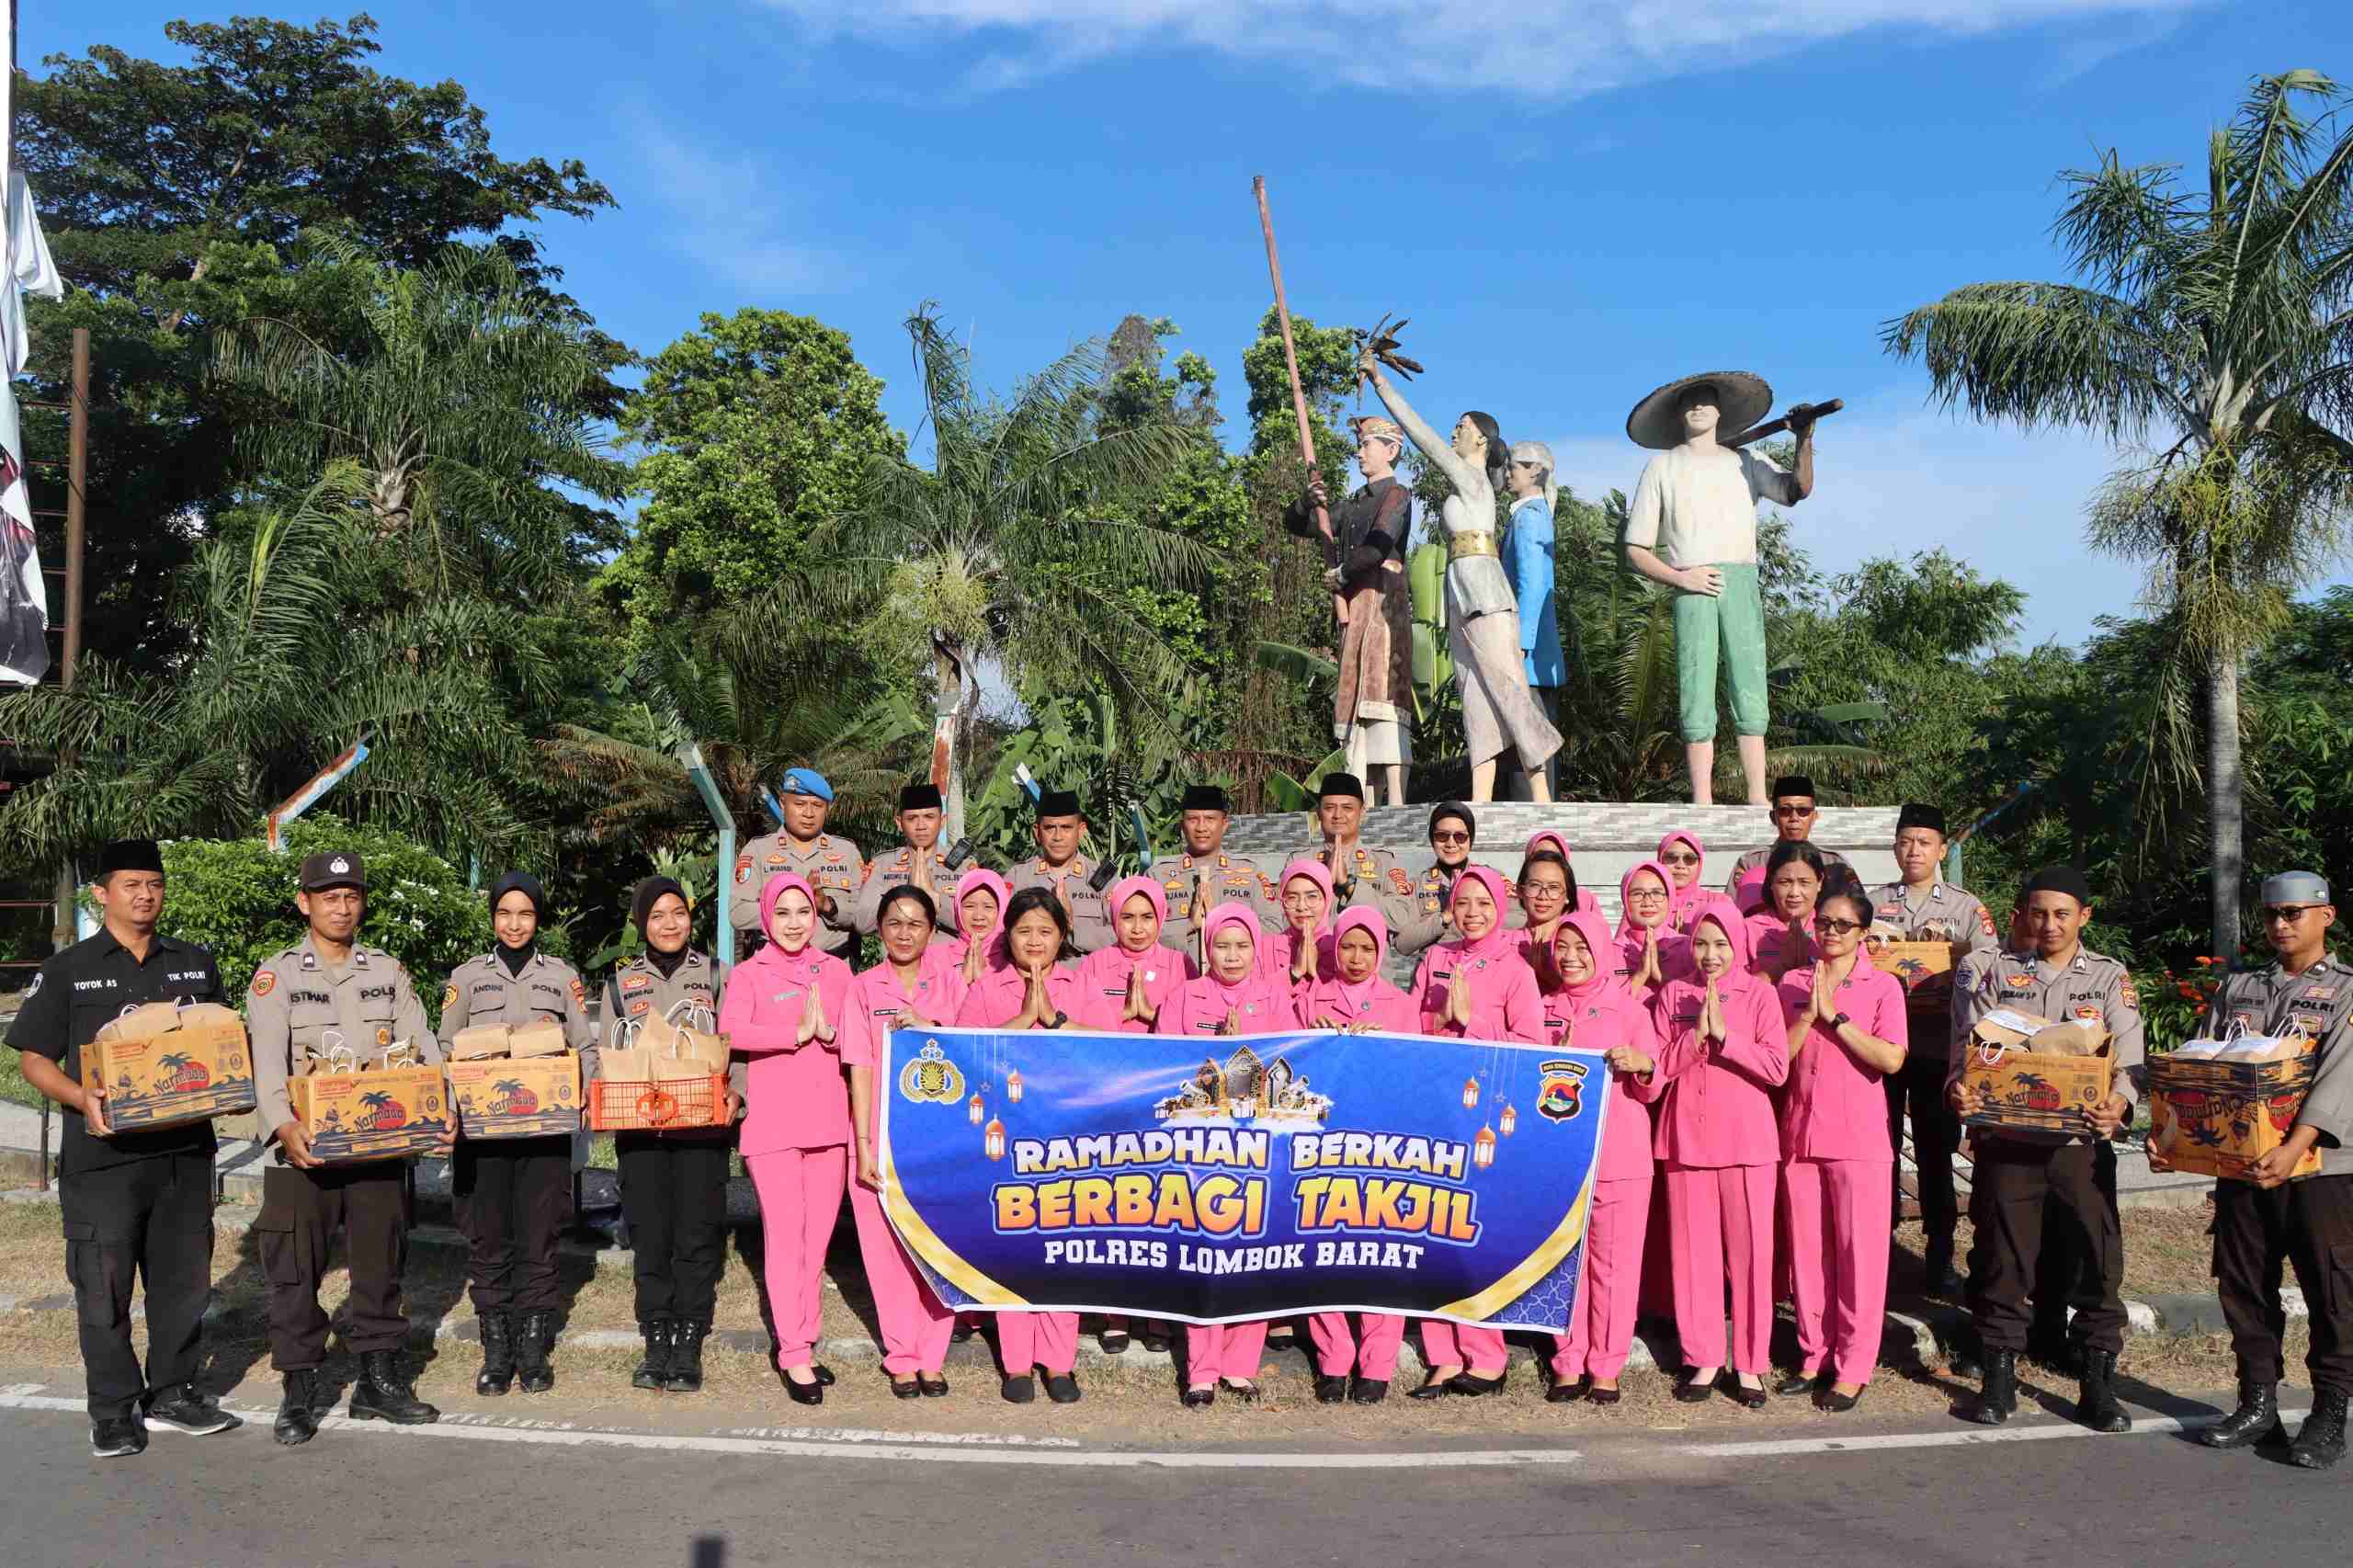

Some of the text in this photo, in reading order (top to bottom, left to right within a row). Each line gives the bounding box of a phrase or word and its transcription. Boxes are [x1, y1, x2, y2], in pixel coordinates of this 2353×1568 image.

[167, 971, 206, 982] TIK POLRI
[74, 979, 118, 991] YOYOK AS
[2069, 993, 2106, 1001] POLRI
[2291, 999, 2335, 1013] POLRI
[1013, 1128, 1466, 1179] RAMADHAN BERKAH
[995, 1172, 1479, 1242] BERBAGI TAKJIL
[1044, 1240, 1424, 1275] POLRES LOMBOK BARAT
